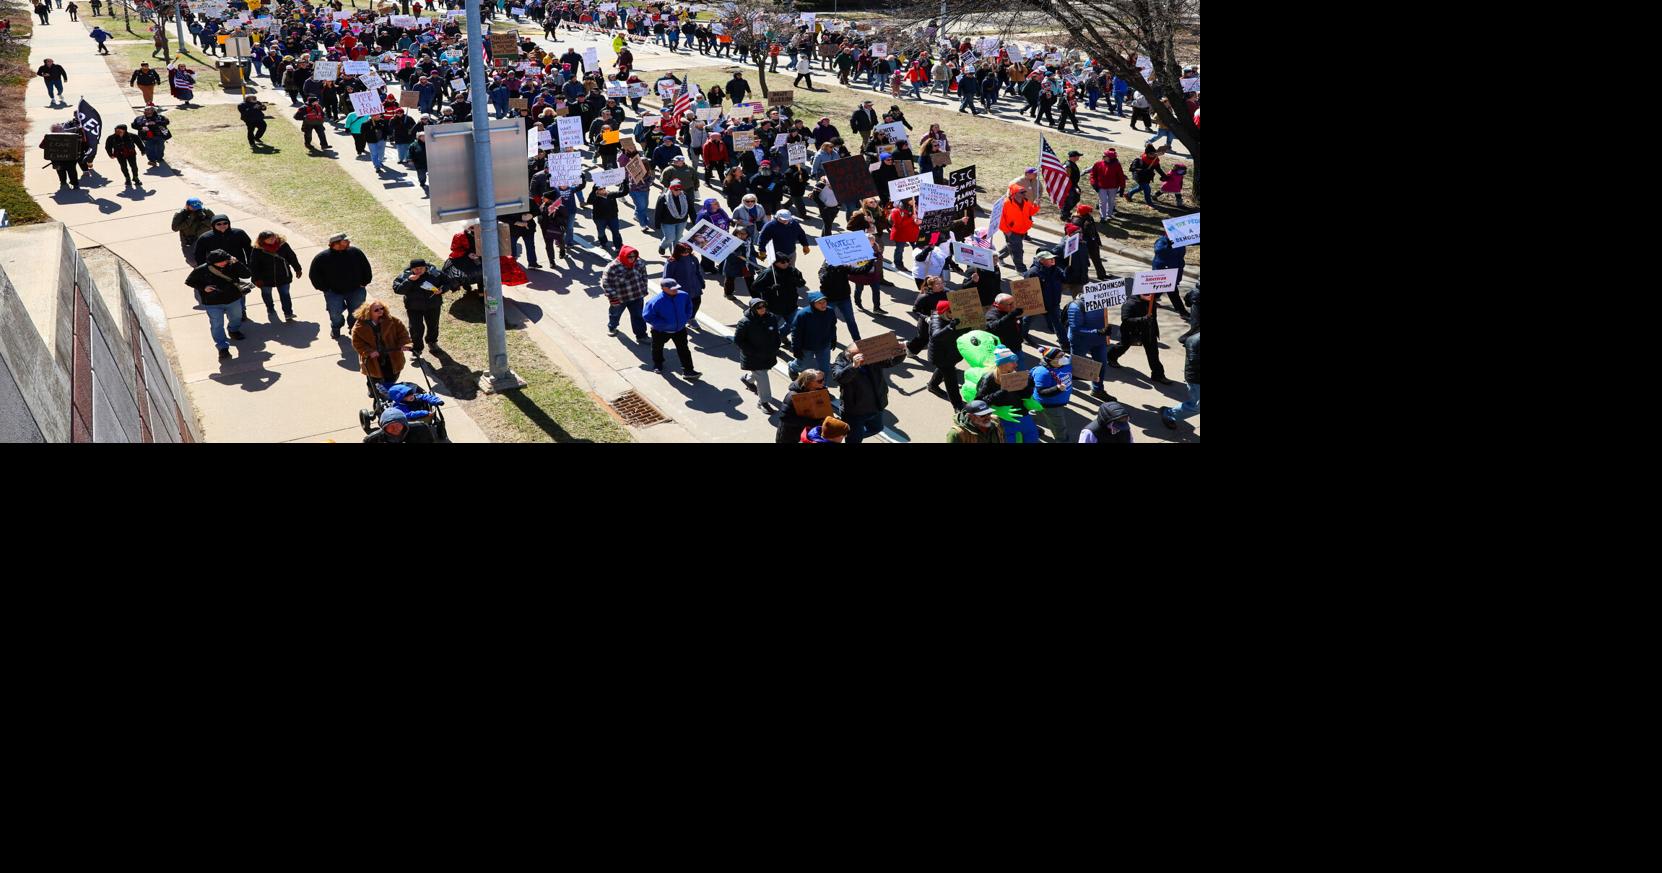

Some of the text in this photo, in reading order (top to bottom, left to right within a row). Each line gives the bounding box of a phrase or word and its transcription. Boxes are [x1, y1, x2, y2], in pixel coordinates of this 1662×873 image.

[951, 169, 973, 185] SIC
[955, 178, 977, 192] EMPER
[955, 197, 975, 211] 1793
[825, 238, 856, 249] PROTECT
[1098, 280, 1125, 291] JOHNSON
[1086, 294, 1127, 311] PEDAPHILES
